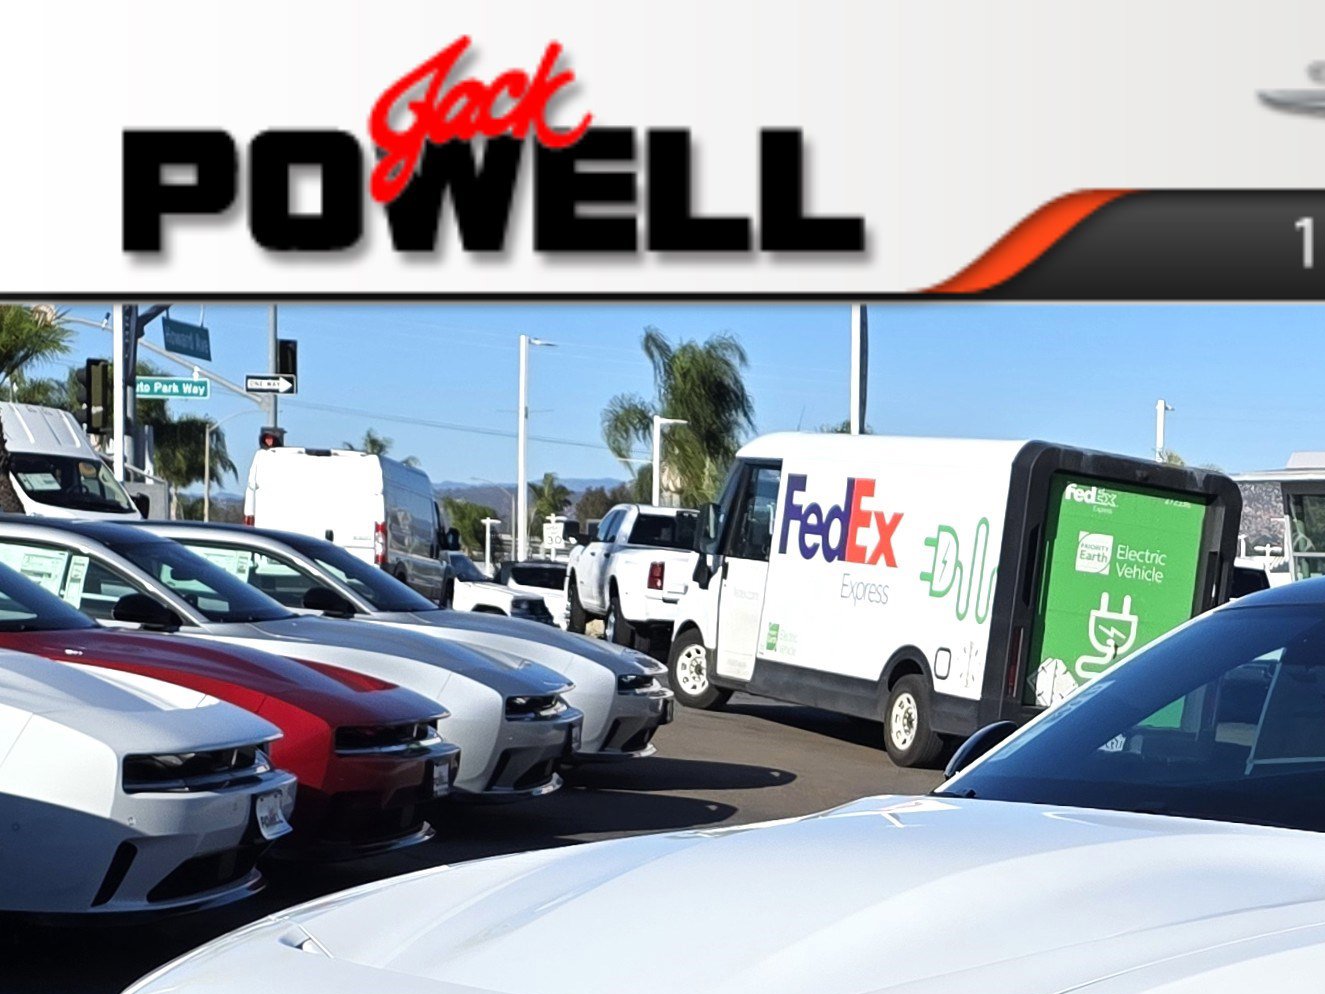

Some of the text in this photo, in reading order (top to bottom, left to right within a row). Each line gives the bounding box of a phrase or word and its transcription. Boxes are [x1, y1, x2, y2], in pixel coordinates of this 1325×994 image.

[135, 381, 205, 396] uto Park Way
[778, 473, 904, 568] FedEx
[1080, 550, 1108, 563] Earth
[1117, 545, 1167, 566] Electric
[1116, 562, 1164, 584] Vehicle
[841, 573, 889, 606] Express
